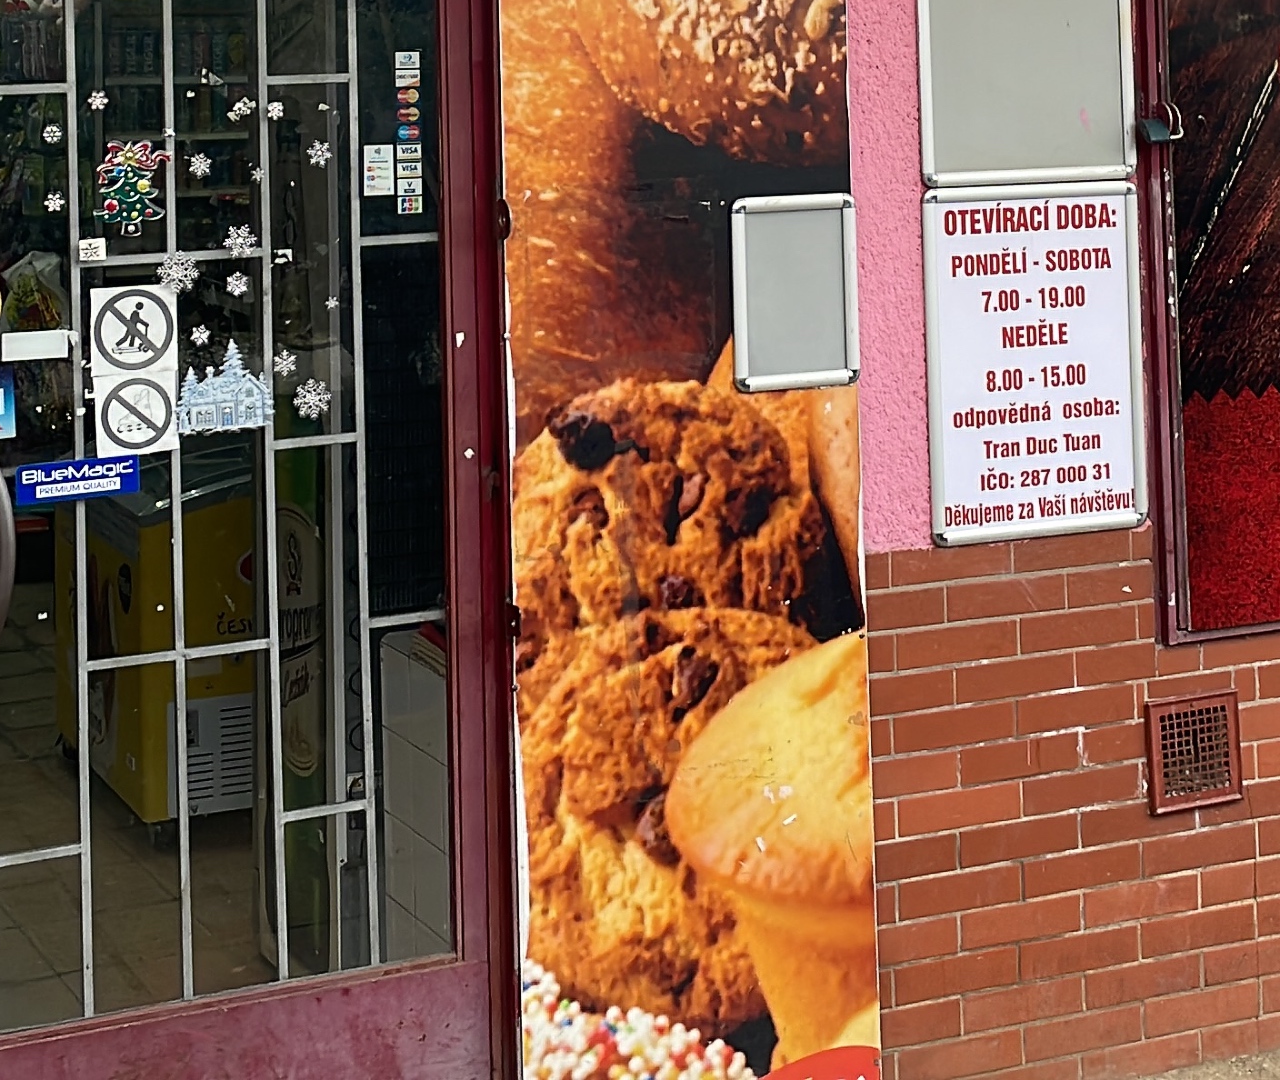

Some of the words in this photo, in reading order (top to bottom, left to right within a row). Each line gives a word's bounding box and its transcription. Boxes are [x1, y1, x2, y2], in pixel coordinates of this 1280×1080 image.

[944, 200, 1050, 236] OTEVÍRACÍ
[1056, 203, 1117, 230] DOBA:
[951, 247, 1027, 278] PONDĚLÍ
[1045, 248, 1111, 272] SOBOTA
[981, 290, 1020, 313] 7.00
[1038, 285, 1085, 309] 19.00
[1002, 318, 1068, 349] NEDĚLE
[986, 369, 1023, 392] 8.00
[1041, 363, 1086, 387] 15.00
[953, 401, 1051, 429] odpovědná
[1063, 398, 1120, 419] osoba:
[983, 440, 1020, 459] Tran
[1026, 437, 1058, 455] Duc
[1063, 434, 1101, 452] Tuan
[39, 483, 80, 495] PREMIUM
[83, 479, 118, 490] QUALITY
[980, 468, 1014, 491] IČO:
[1020, 469, 1051, 487] 287
[1057, 465, 1087, 484] 000
[1092, 463, 1111, 480] 31
[944, 504, 1014, 527] Děkujeme
[1018, 502, 1034, 519] za
[1039, 494, 1066, 517] Vaší
[1070, 488, 1135, 515] návštěvu!
